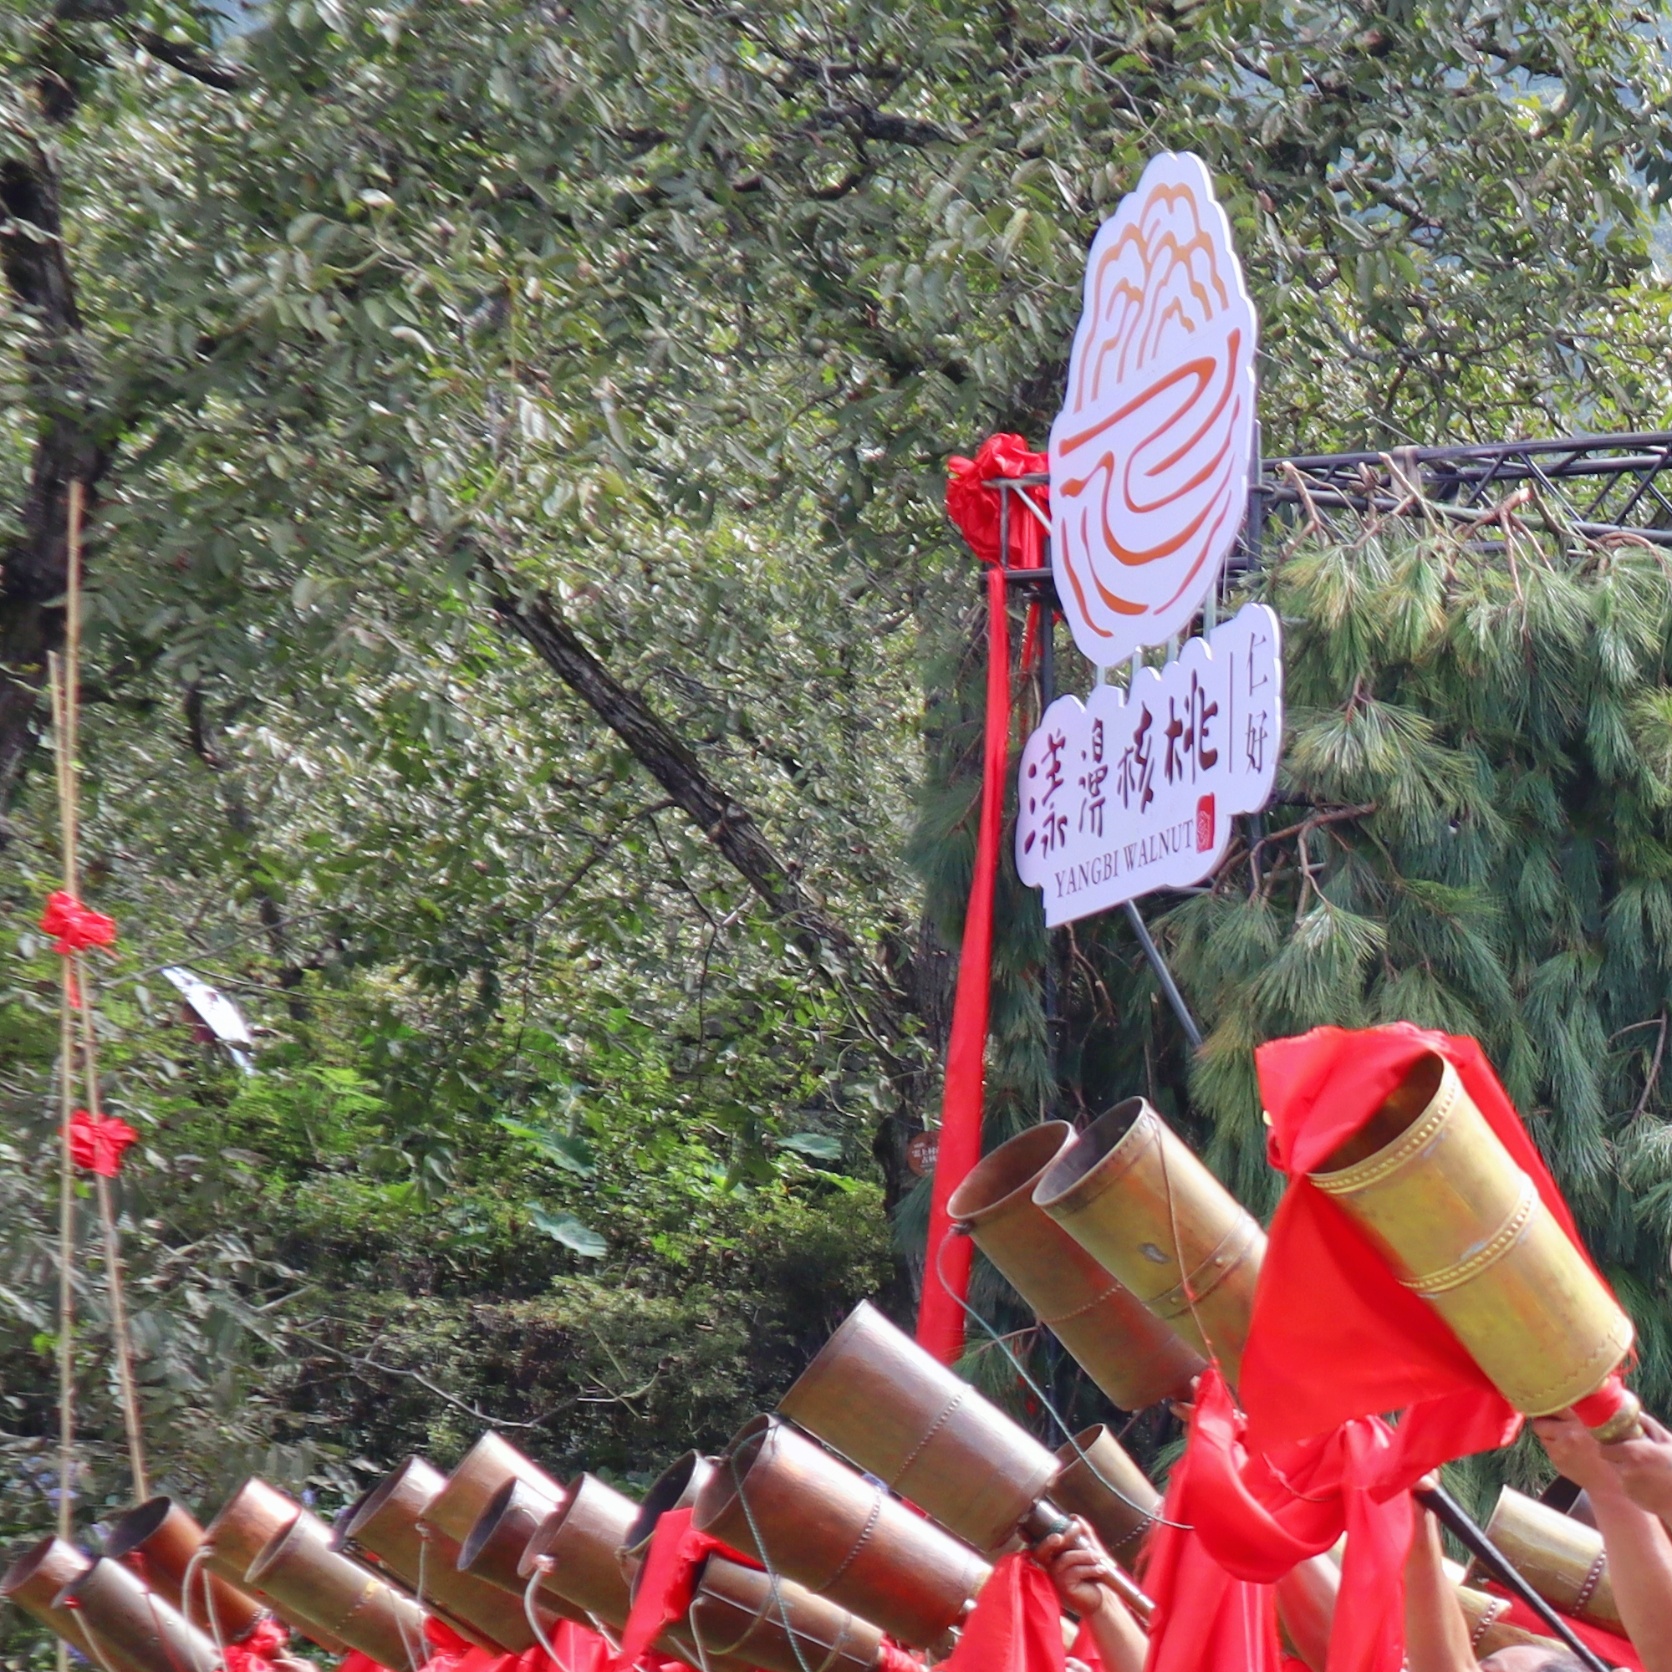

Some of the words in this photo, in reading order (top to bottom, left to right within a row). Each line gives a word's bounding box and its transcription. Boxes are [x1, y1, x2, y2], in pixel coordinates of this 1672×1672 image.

[1024, 669, 1219, 858] 漾濞核桃
[1054, 850, 1119, 898] YANGBI
[1123, 820, 1194, 874] WALNUT
